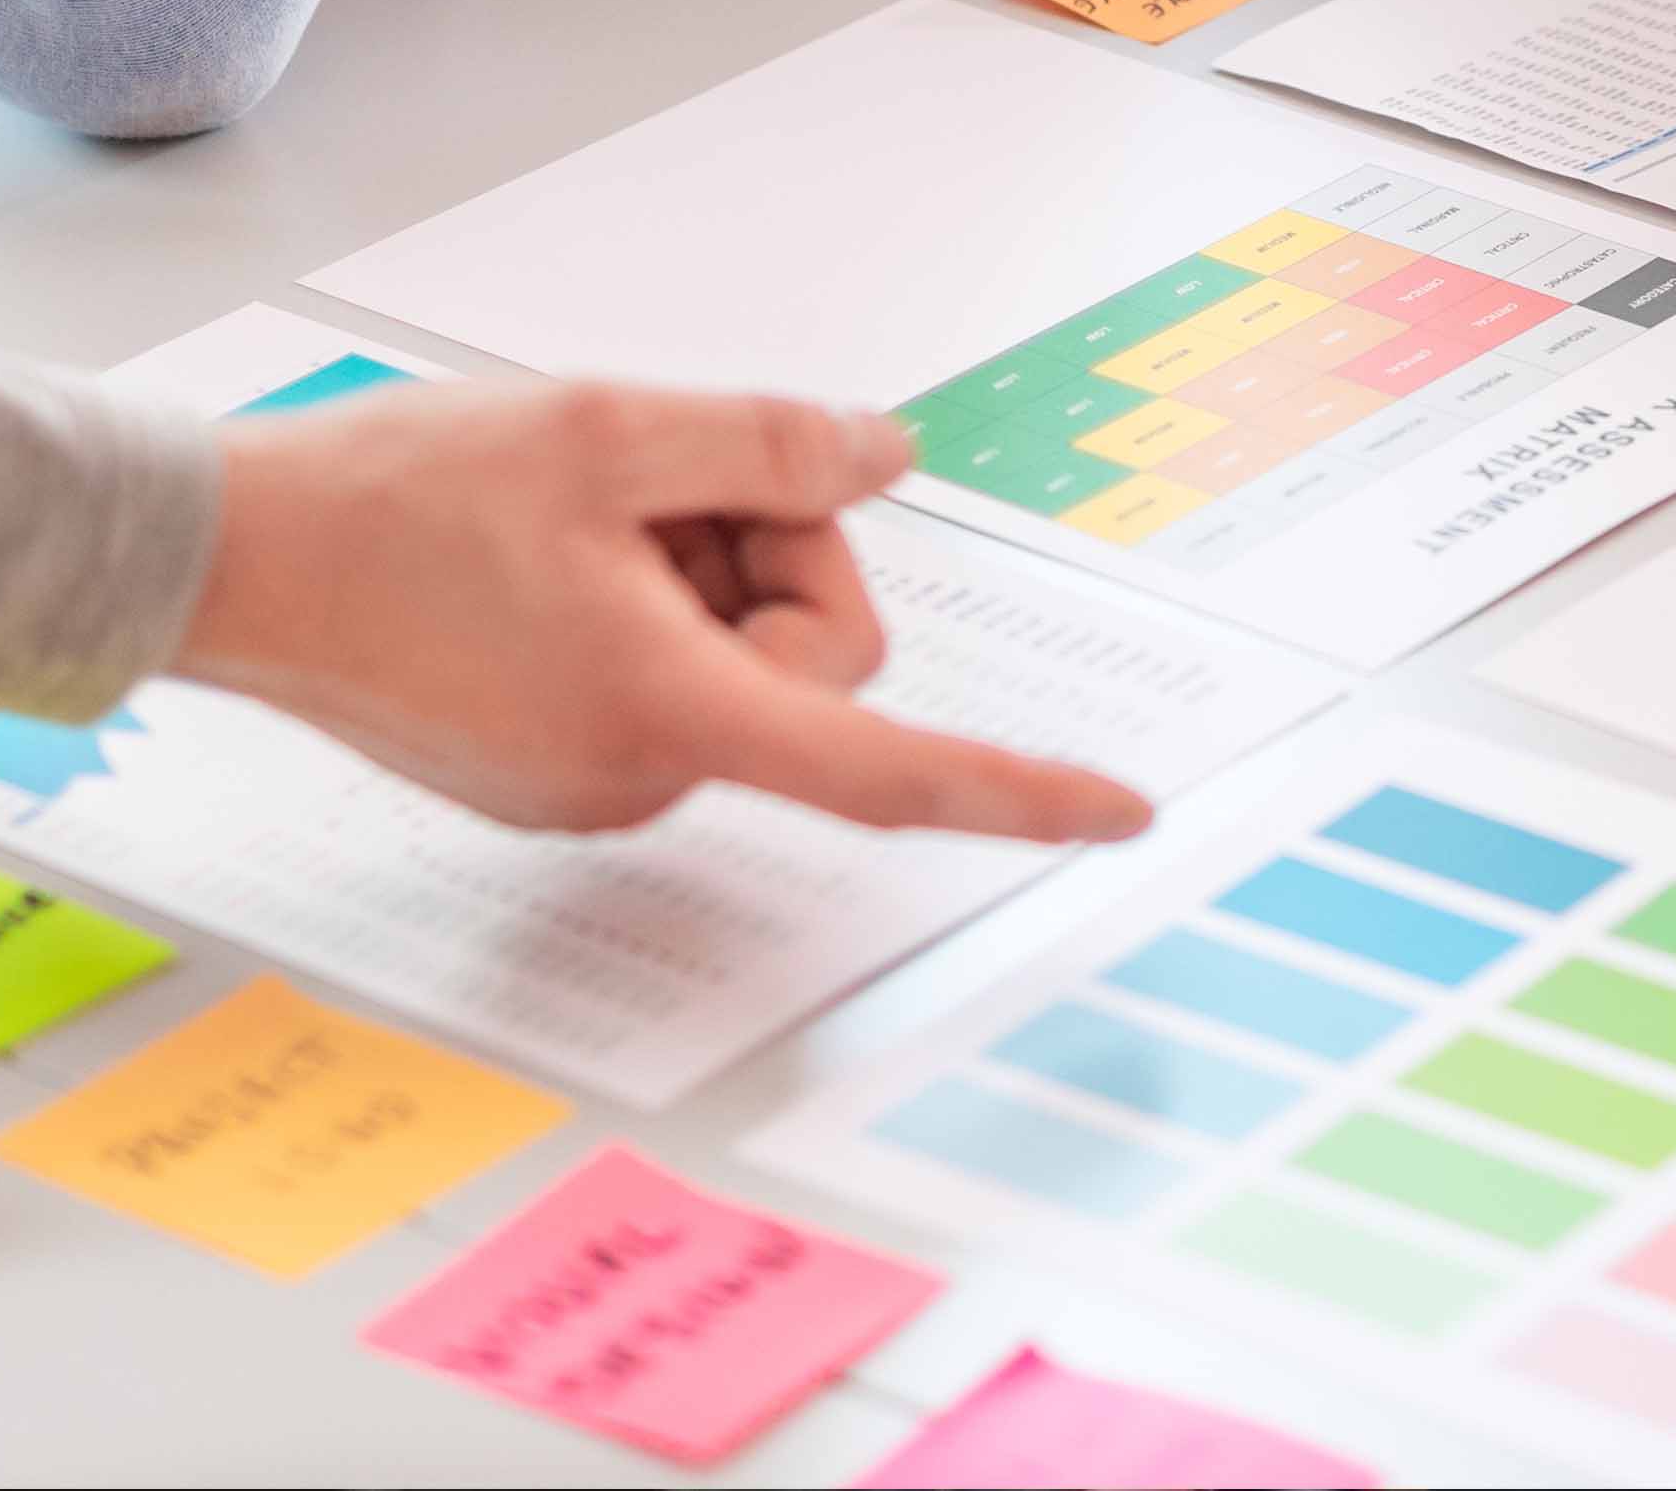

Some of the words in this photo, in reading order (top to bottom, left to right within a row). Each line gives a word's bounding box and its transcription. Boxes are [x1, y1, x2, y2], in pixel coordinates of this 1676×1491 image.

[1410, 205, 1461, 235] MARGINAL
[1483, 231, 1530, 258] CRITICAL
[1542, 246, 1619, 290] CATASTROPHIC
[1464, 405, 1611, 482] MATRIX
[1413, 417, 1656, 556] ASSESSMENT
